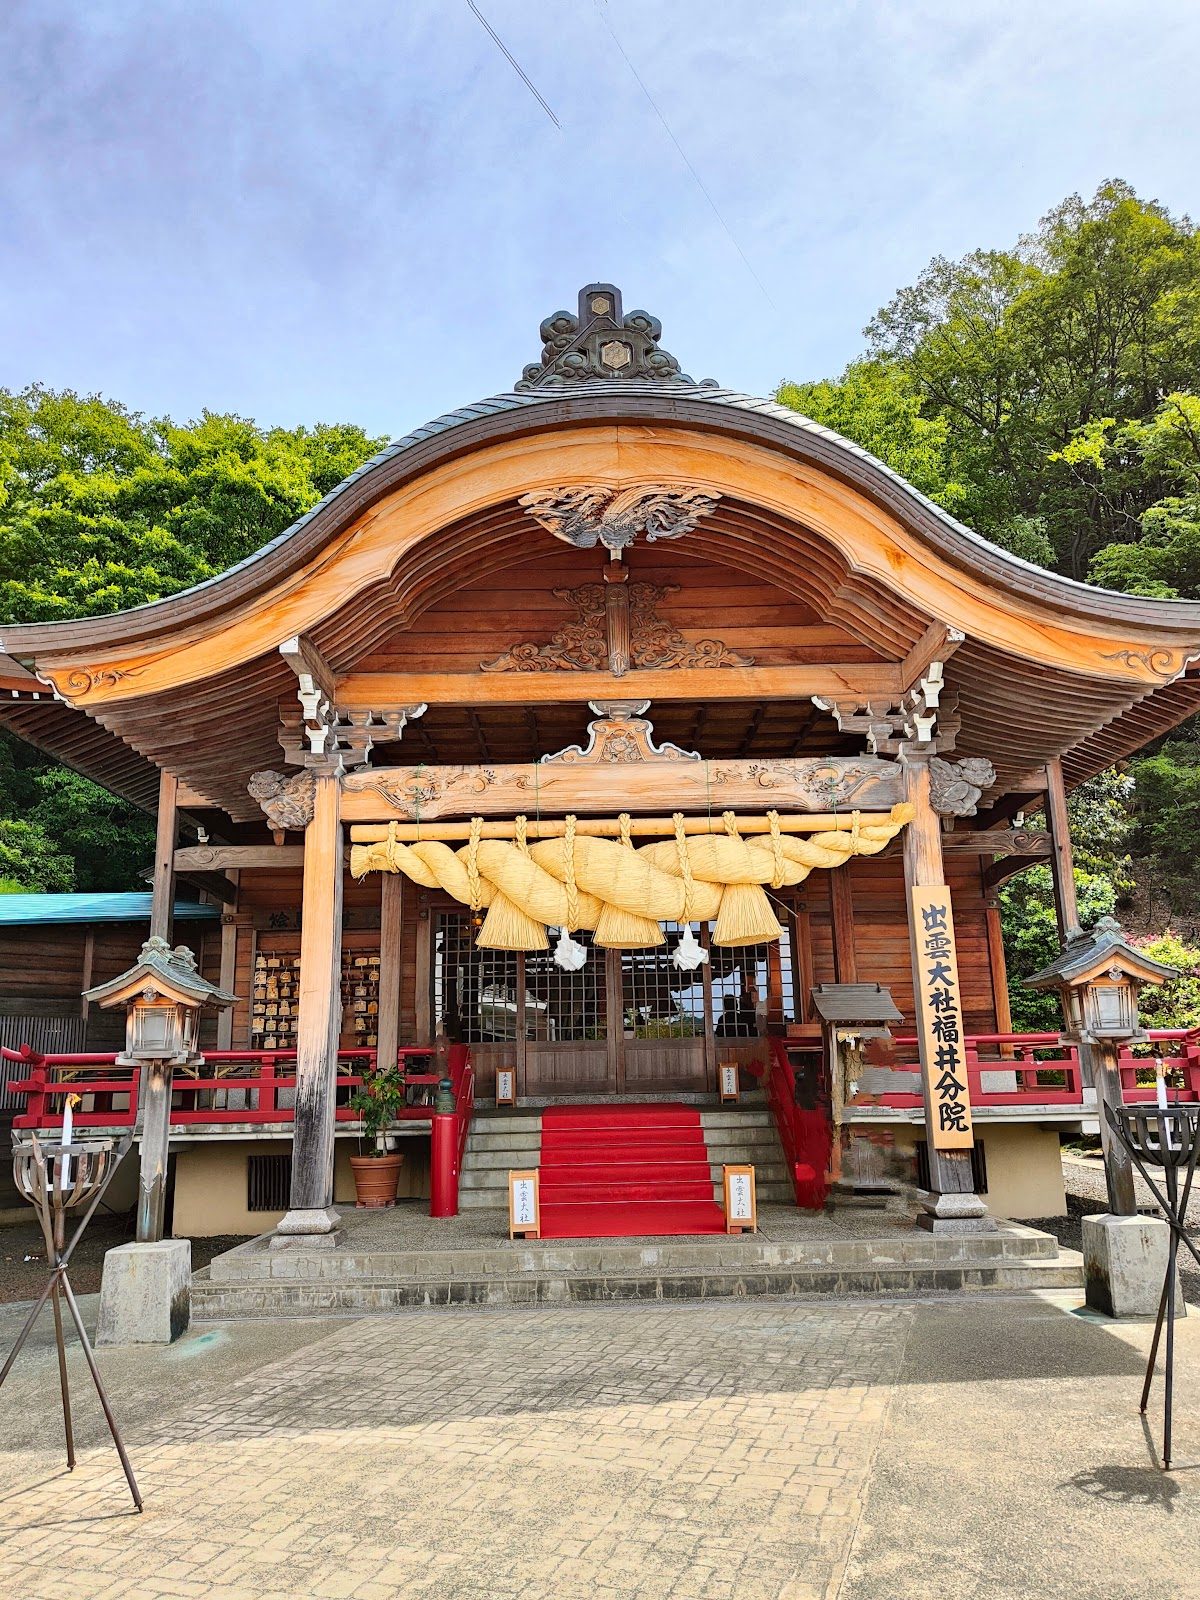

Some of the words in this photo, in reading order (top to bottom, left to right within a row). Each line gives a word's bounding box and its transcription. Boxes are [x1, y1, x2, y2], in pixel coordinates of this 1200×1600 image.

[920, 903, 970, 1132] 出雲大社福井分院
[519, 1179, 531, 1223] 出雲大社
[735, 1174, 747, 1217] 出雲大社
